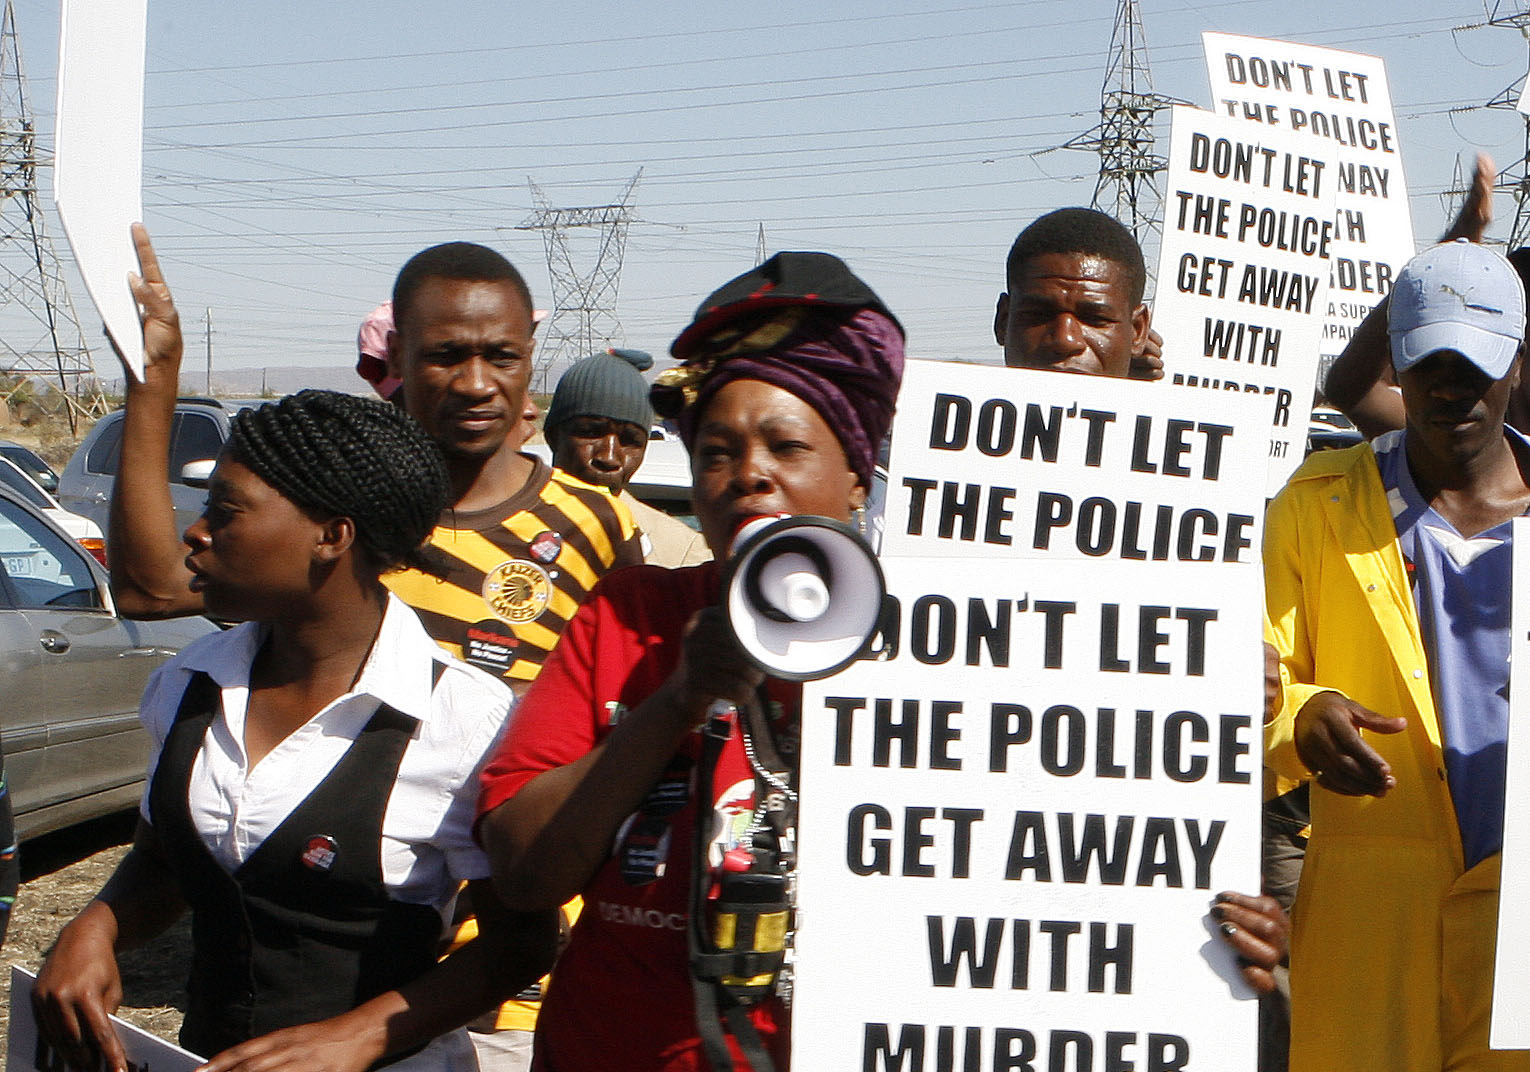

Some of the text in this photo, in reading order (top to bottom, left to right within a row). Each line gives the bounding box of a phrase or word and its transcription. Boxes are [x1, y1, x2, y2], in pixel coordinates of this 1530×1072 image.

[1225, 53, 1368, 104] DON'T LET
[1190, 140, 1325, 199] DON'T LET
[1338, 161, 1389, 199] WAY
[1176, 190, 1231, 239] THE
[1237, 203, 1332, 260] POLICE
[1177, 252, 1319, 314] GET AWAY
[1329, 257, 1392, 295] DER
[1203, 317, 1282, 367] WITH
[929, 393, 1116, 466] DON'T
[1130, 415, 1233, 481] LET
[903, 478, 1255, 563] THE POLICE
[1100, 603, 1218, 676] LET
[825, 697, 1252, 785] THE POLICE
[846, 803, 1227, 890] GET AWAY
[926, 915, 1136, 995] WITH
